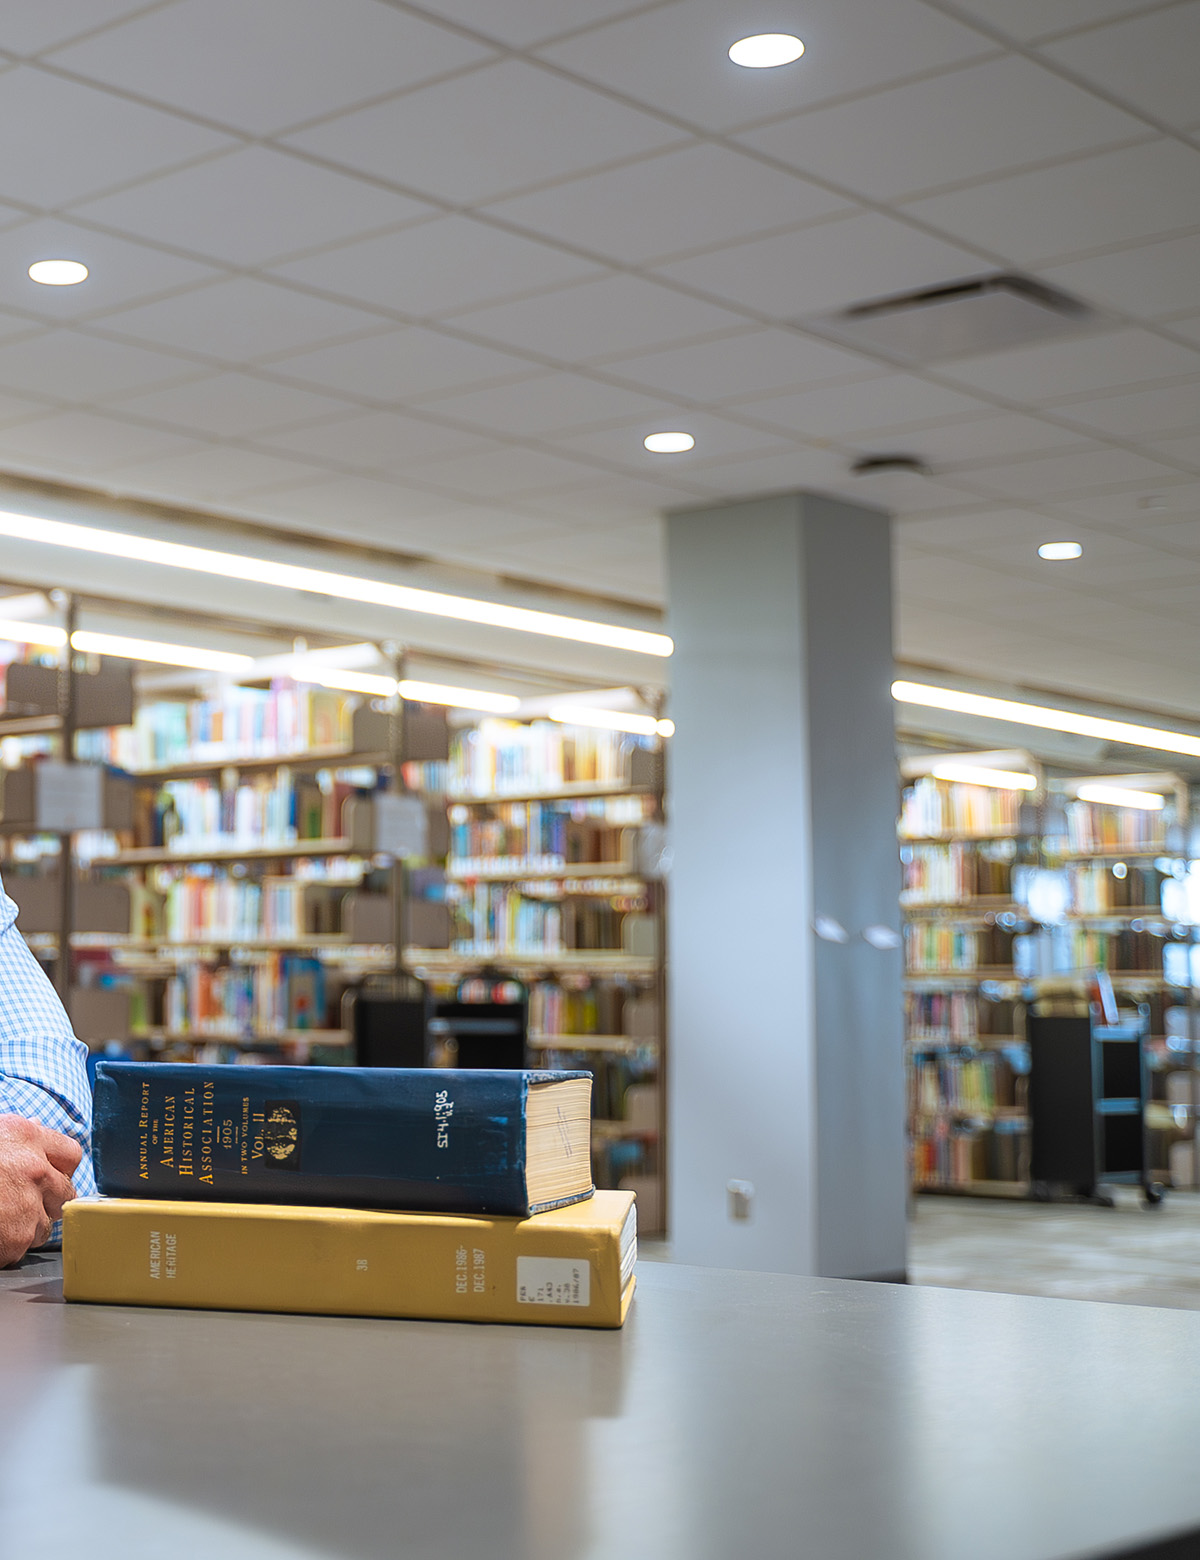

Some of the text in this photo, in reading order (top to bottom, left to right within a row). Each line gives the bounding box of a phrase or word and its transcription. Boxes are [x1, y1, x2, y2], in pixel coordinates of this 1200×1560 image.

[138, 1082, 150, 1180] ANNUAL REPORT
[152, 1134, 158, 1145] OF
[160, 1095, 175, 1168] AMERICAN
[178, 1087, 195, 1176] HISTORICAL
[198, 1081, 215, 1185] ASSOCIATION
[222, 1119, 233, 1149] 1905
[241, 1096, 250, 1138] VOLUMES
[252, 1112, 265, 1122] II
[241, 1165, 248, 1175] IN
[150, 1230, 161, 1279] AMERICAN
[165, 1233, 177, 1279] HERITAGE
